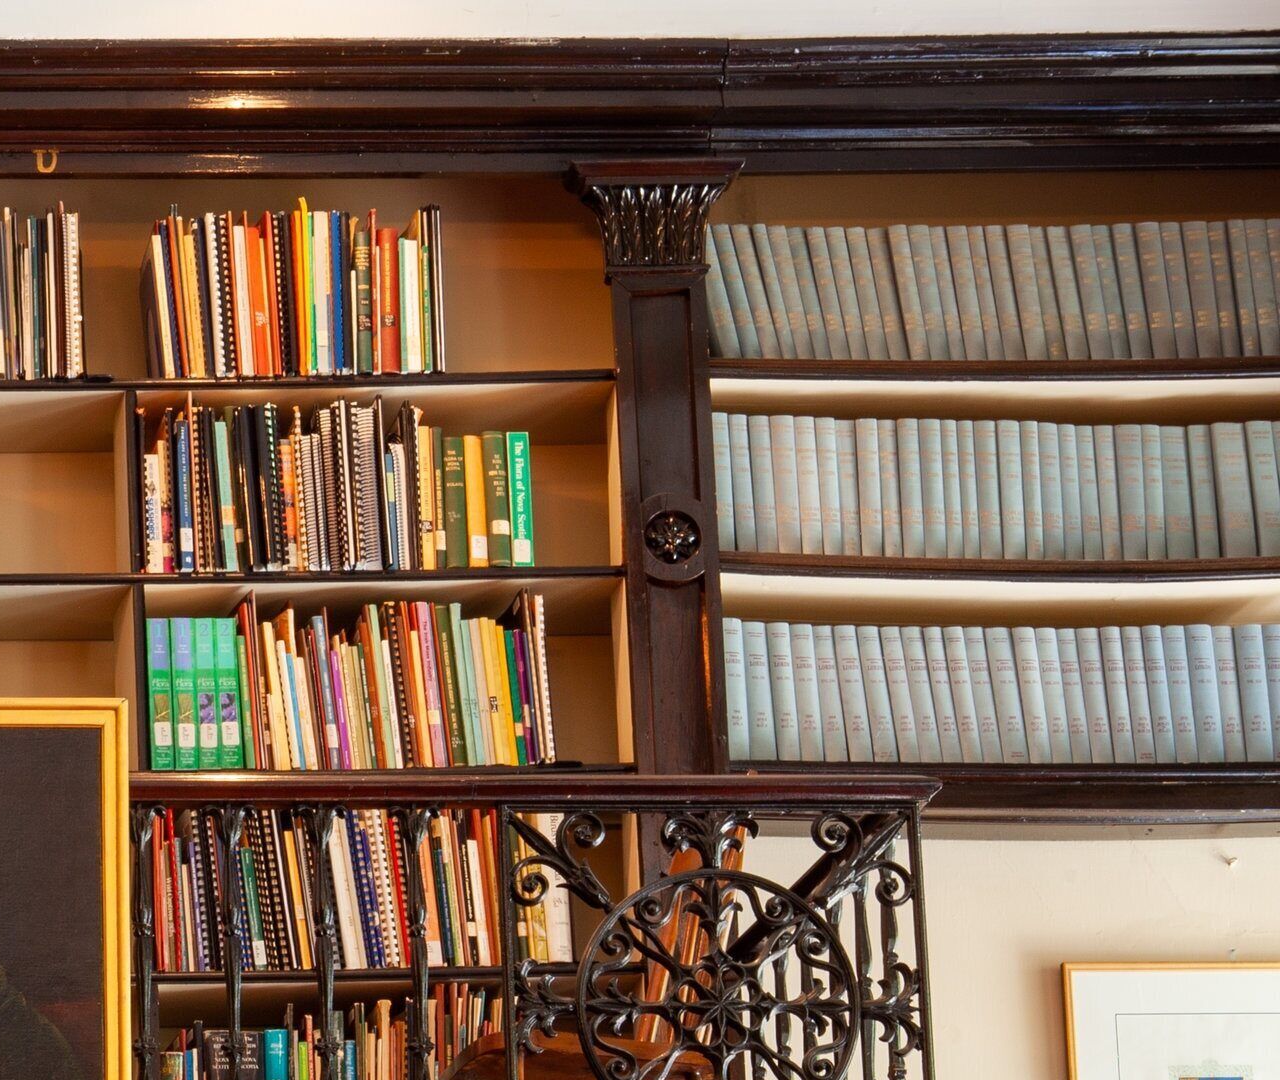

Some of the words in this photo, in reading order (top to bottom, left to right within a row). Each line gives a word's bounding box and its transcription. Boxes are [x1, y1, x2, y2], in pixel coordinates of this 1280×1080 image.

[514, 441, 524, 456] The
[515, 457, 525, 481] Flora
[516, 481, 526, 491] of
[517, 492, 526, 512] Nova
